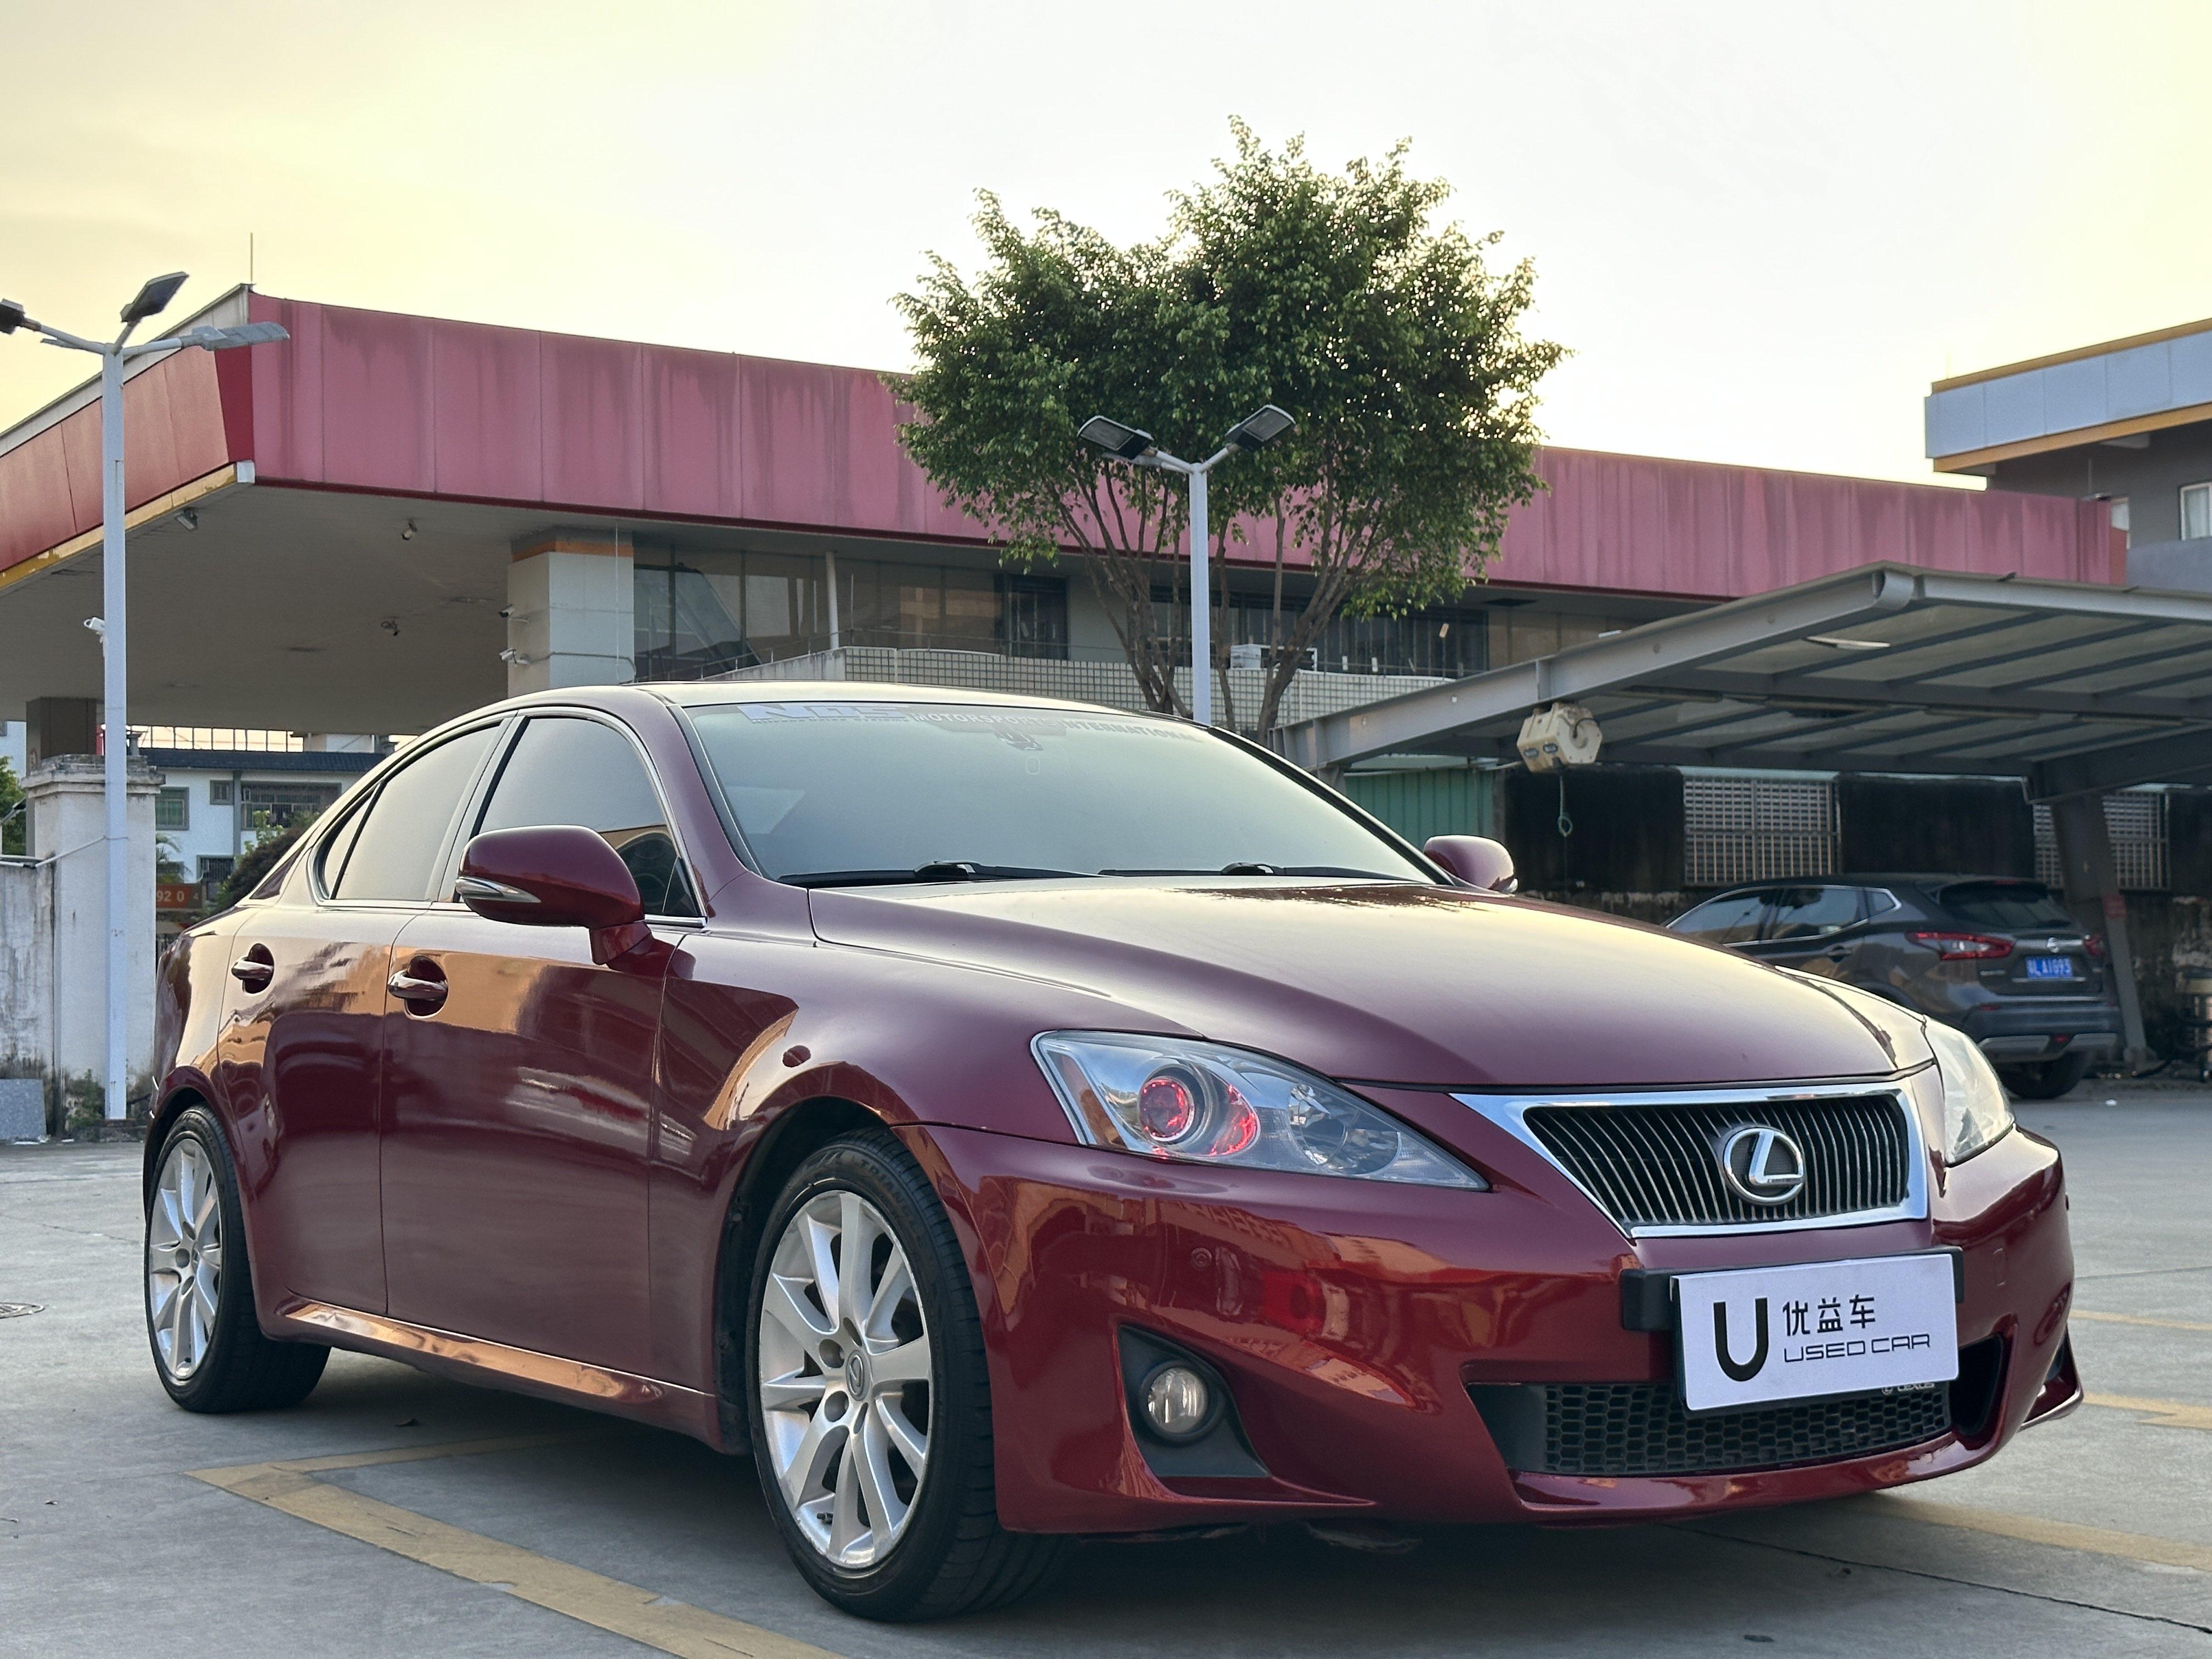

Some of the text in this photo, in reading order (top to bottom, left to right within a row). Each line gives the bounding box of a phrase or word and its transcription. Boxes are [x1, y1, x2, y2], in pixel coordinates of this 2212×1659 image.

[911, 712, 1056, 727] MOTORSPORTS
[1782, 1294, 1876, 1336] 优益车
[1713, 1296, 1769, 1382] U
[1784, 1333, 1931, 1363] USED CAR
